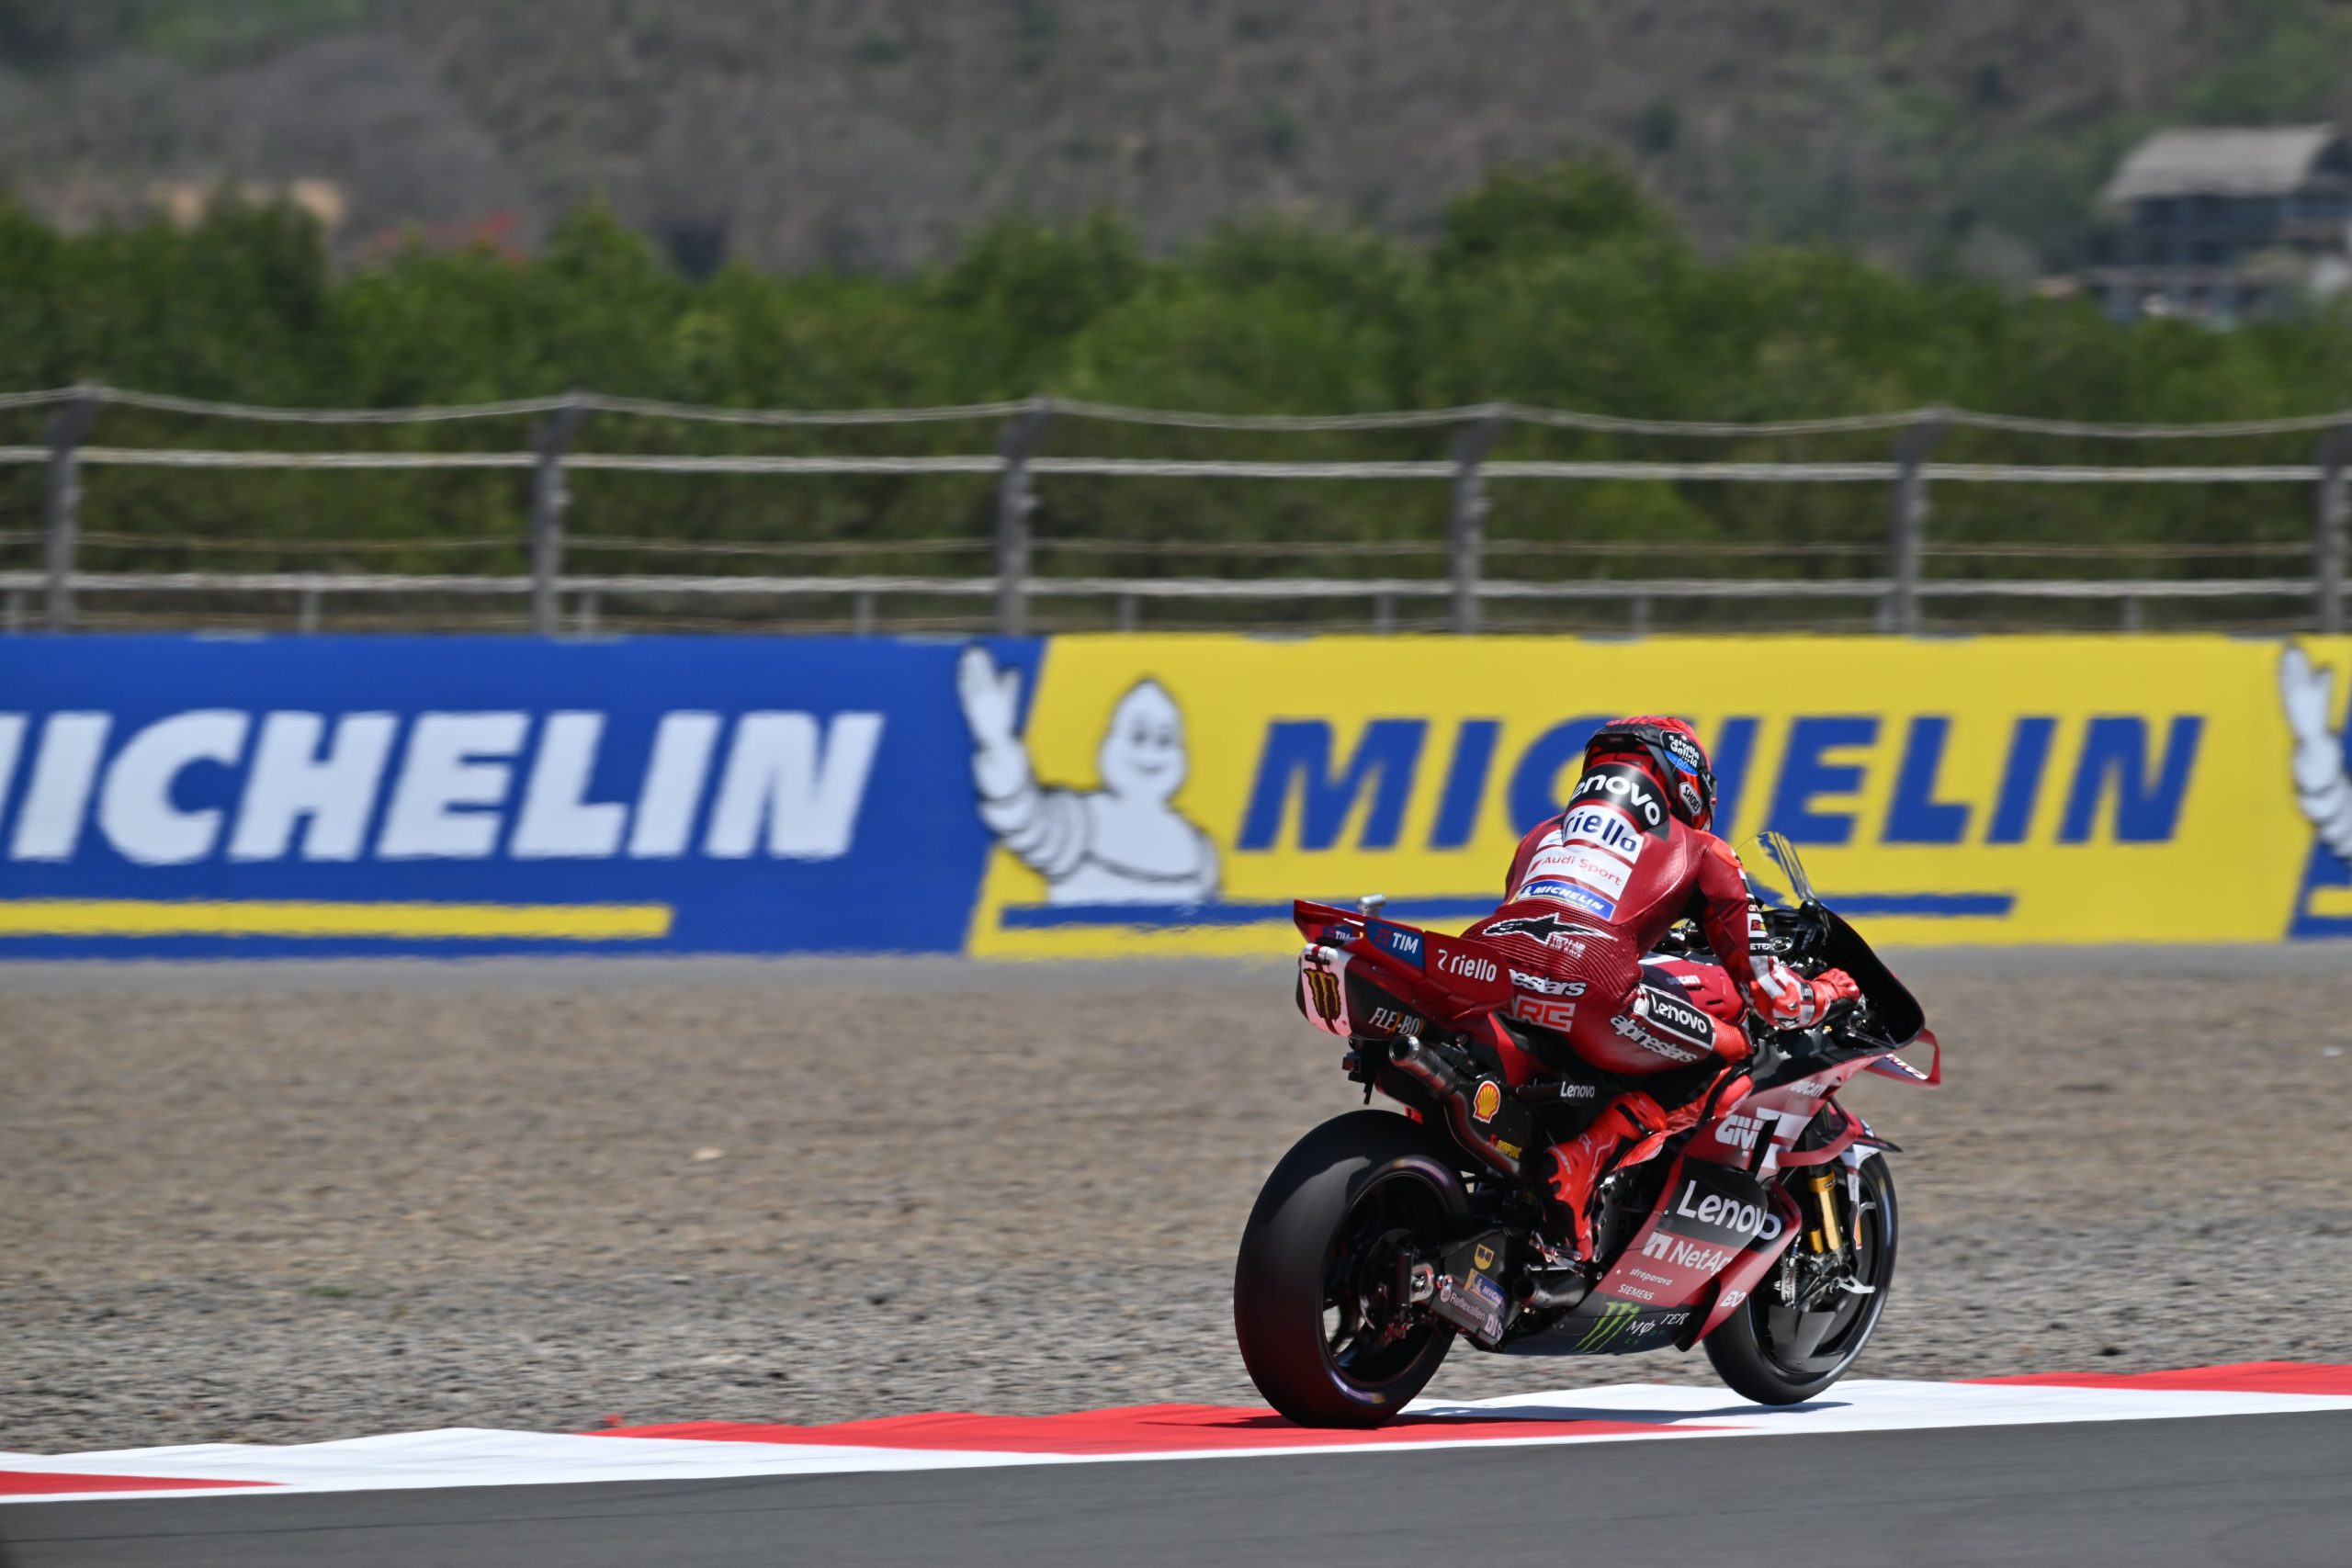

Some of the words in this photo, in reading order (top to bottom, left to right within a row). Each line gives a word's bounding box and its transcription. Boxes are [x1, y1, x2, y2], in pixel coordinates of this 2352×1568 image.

[0, 710, 884, 865] ICHELIN
[1570, 773, 1661, 826] enovo
[1682, 785, 1701, 813] SHOEI
[1565, 811, 1637, 853] riello
[1542, 854, 1575, 865] Audi
[1579, 858, 1622, 886] Sport
[1533, 886, 1605, 911] MICHELIN
[1393, 931, 1419, 954] TIM
[1450, 954, 1497, 982] riello
[1509, 968, 1587, 997] estars
[1667, 975, 1701, 986] DUCATI
[1651, 993, 1708, 1034] Lenovo
[1610, 1014, 1698, 1063] alpinestars
[1560, 1080, 1596, 1099] Lenovo
[1676, 1179, 1782, 1240] Lenovo
[1668, 1240, 1733, 1276] NetAp
[1450, 1292, 1486, 1321] Reflexallen
[1618, 1283, 1656, 1301] SIEMENS
